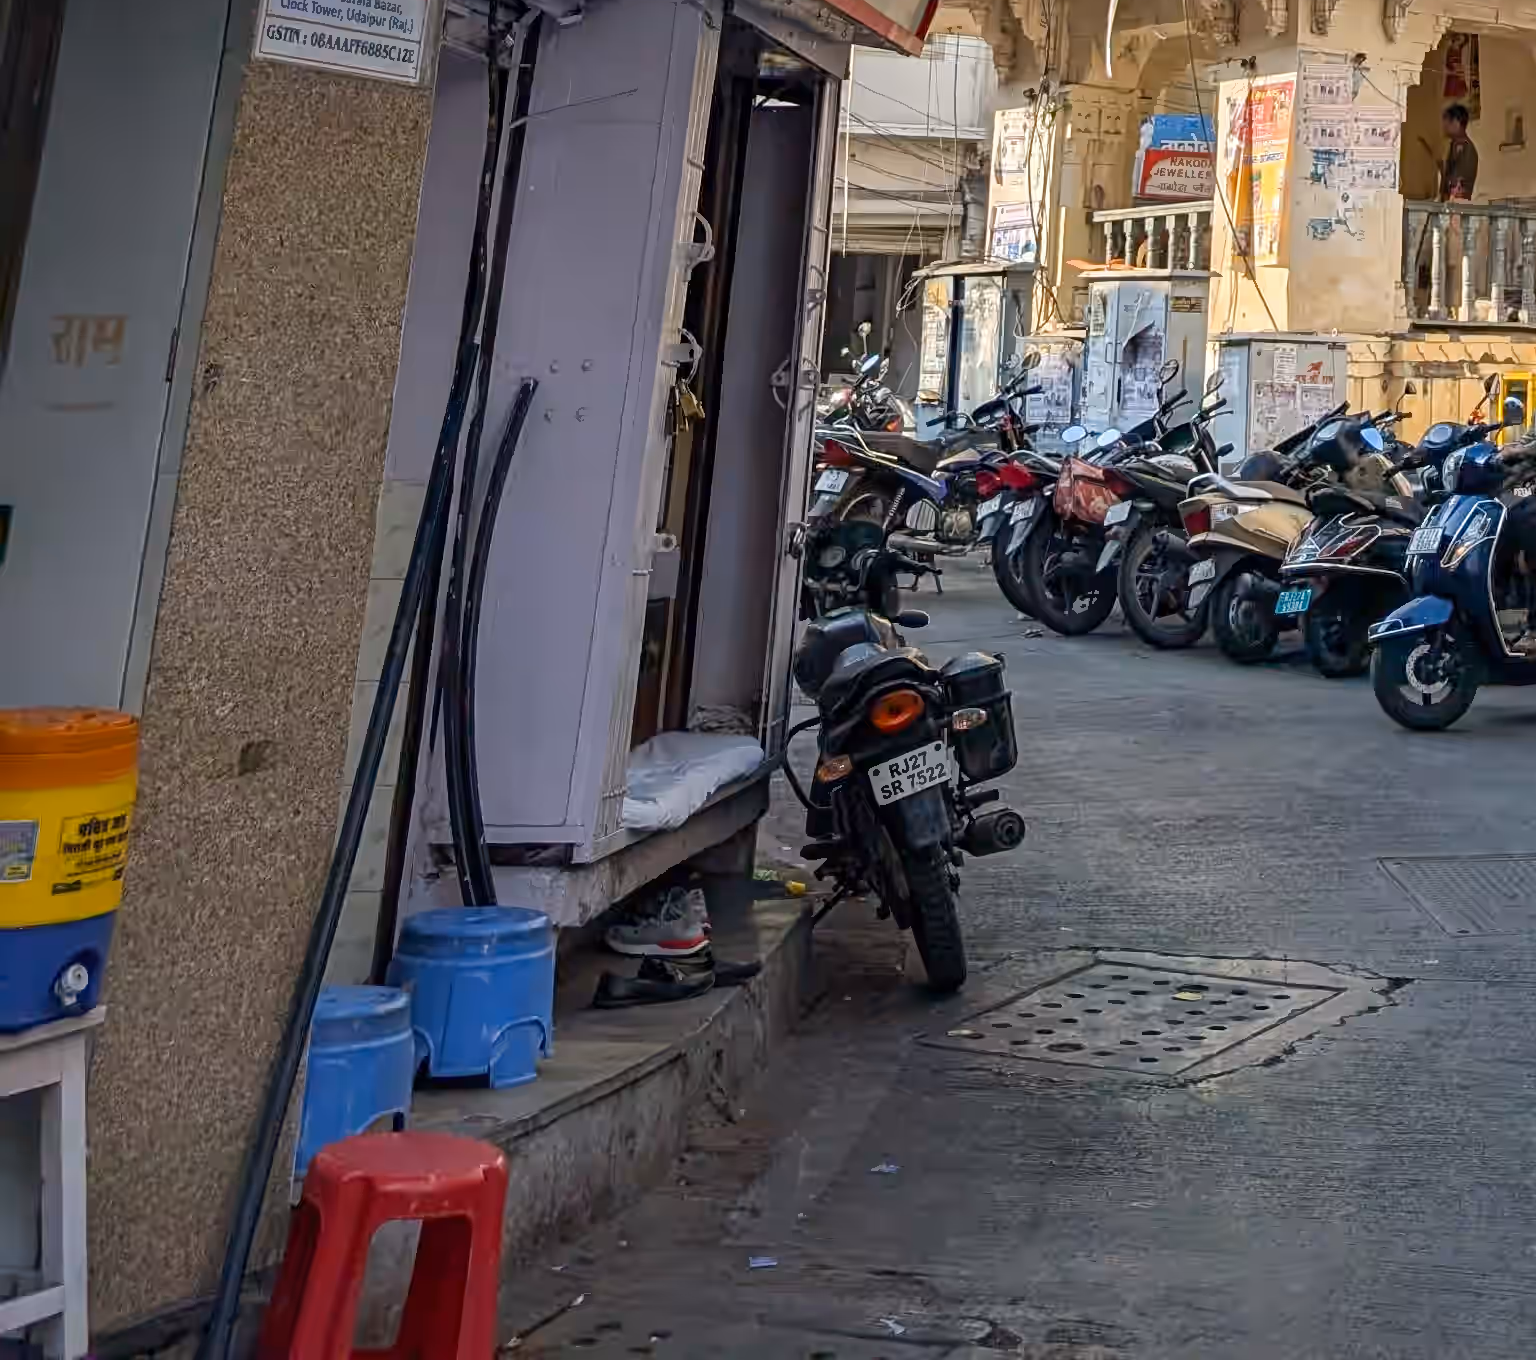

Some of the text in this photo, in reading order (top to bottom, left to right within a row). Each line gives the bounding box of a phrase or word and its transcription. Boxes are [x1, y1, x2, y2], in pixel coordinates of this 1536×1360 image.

[311, 0, 344, 21] Tower,
[346, 9, 387, 28] Udaipur
[889, 751, 928, 778] RJ27
[881, 762, 947, 799] SR 7522
